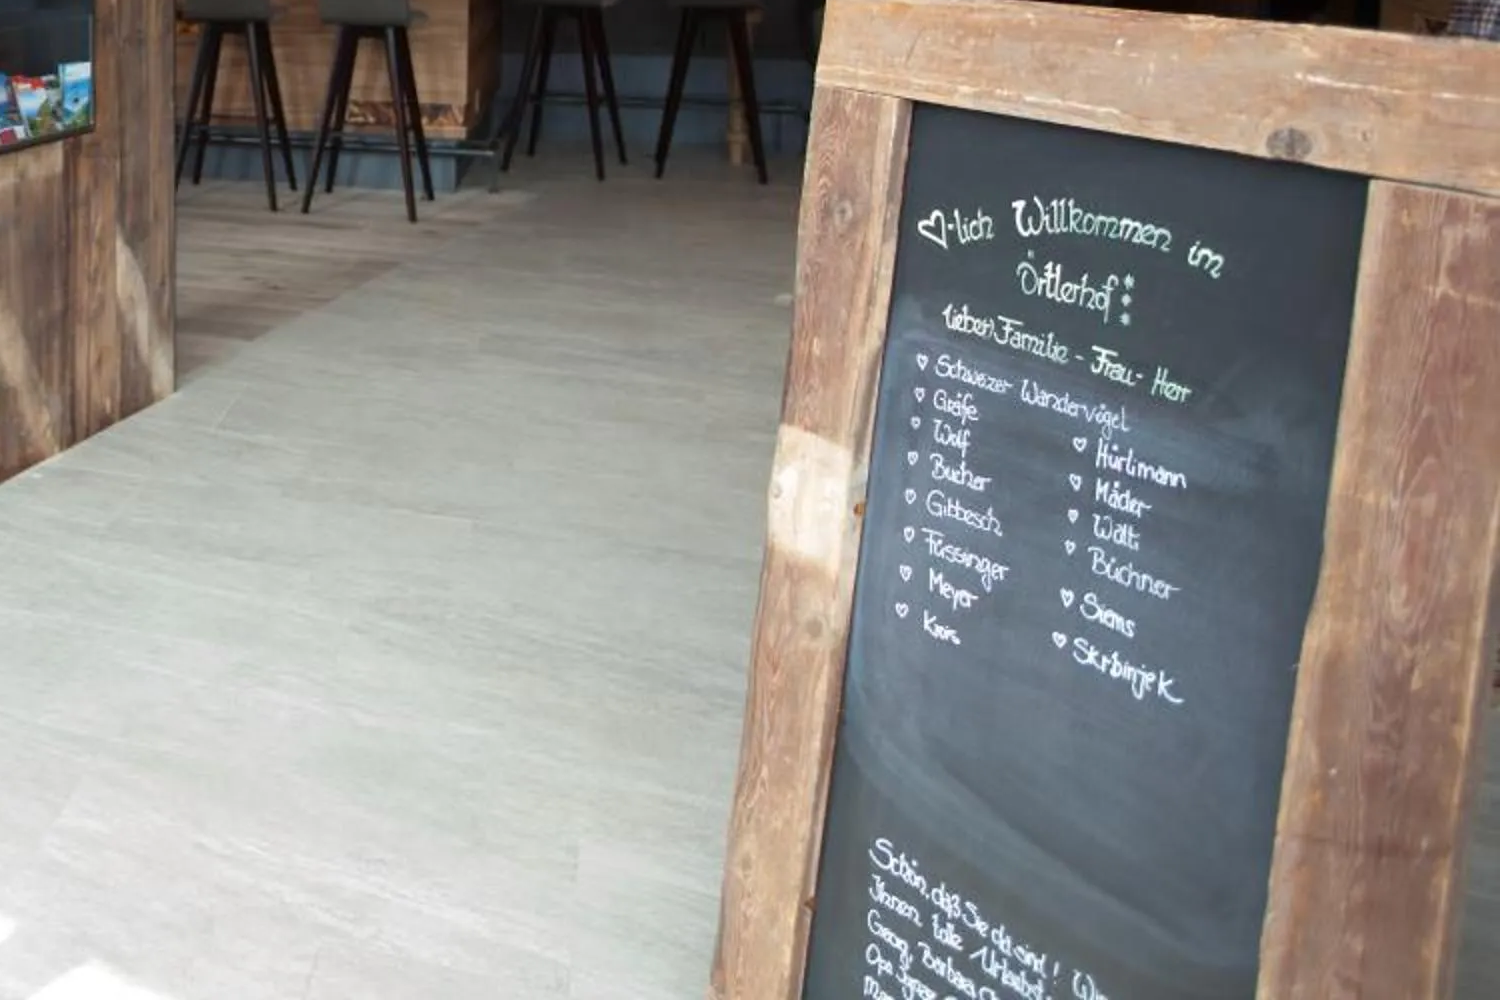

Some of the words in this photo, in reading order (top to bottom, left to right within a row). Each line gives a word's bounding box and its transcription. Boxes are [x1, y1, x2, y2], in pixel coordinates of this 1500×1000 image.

[1012, 196, 1172, 252] Willkommen
[1187, 240, 1225, 278] im
[994, 315, 1069, 364] Familie
[1151, 365, 1193, 404] Herr
[1020, 379, 1131, 441] Wandervögel
[933, 419, 971, 459] Wolf
[1095, 438, 1187, 490] Hürlimann
[929, 453, 993, 492] Bucher
[1095, 477, 1153, 518] Mäder
[1087, 546, 1183, 600] Büchner
